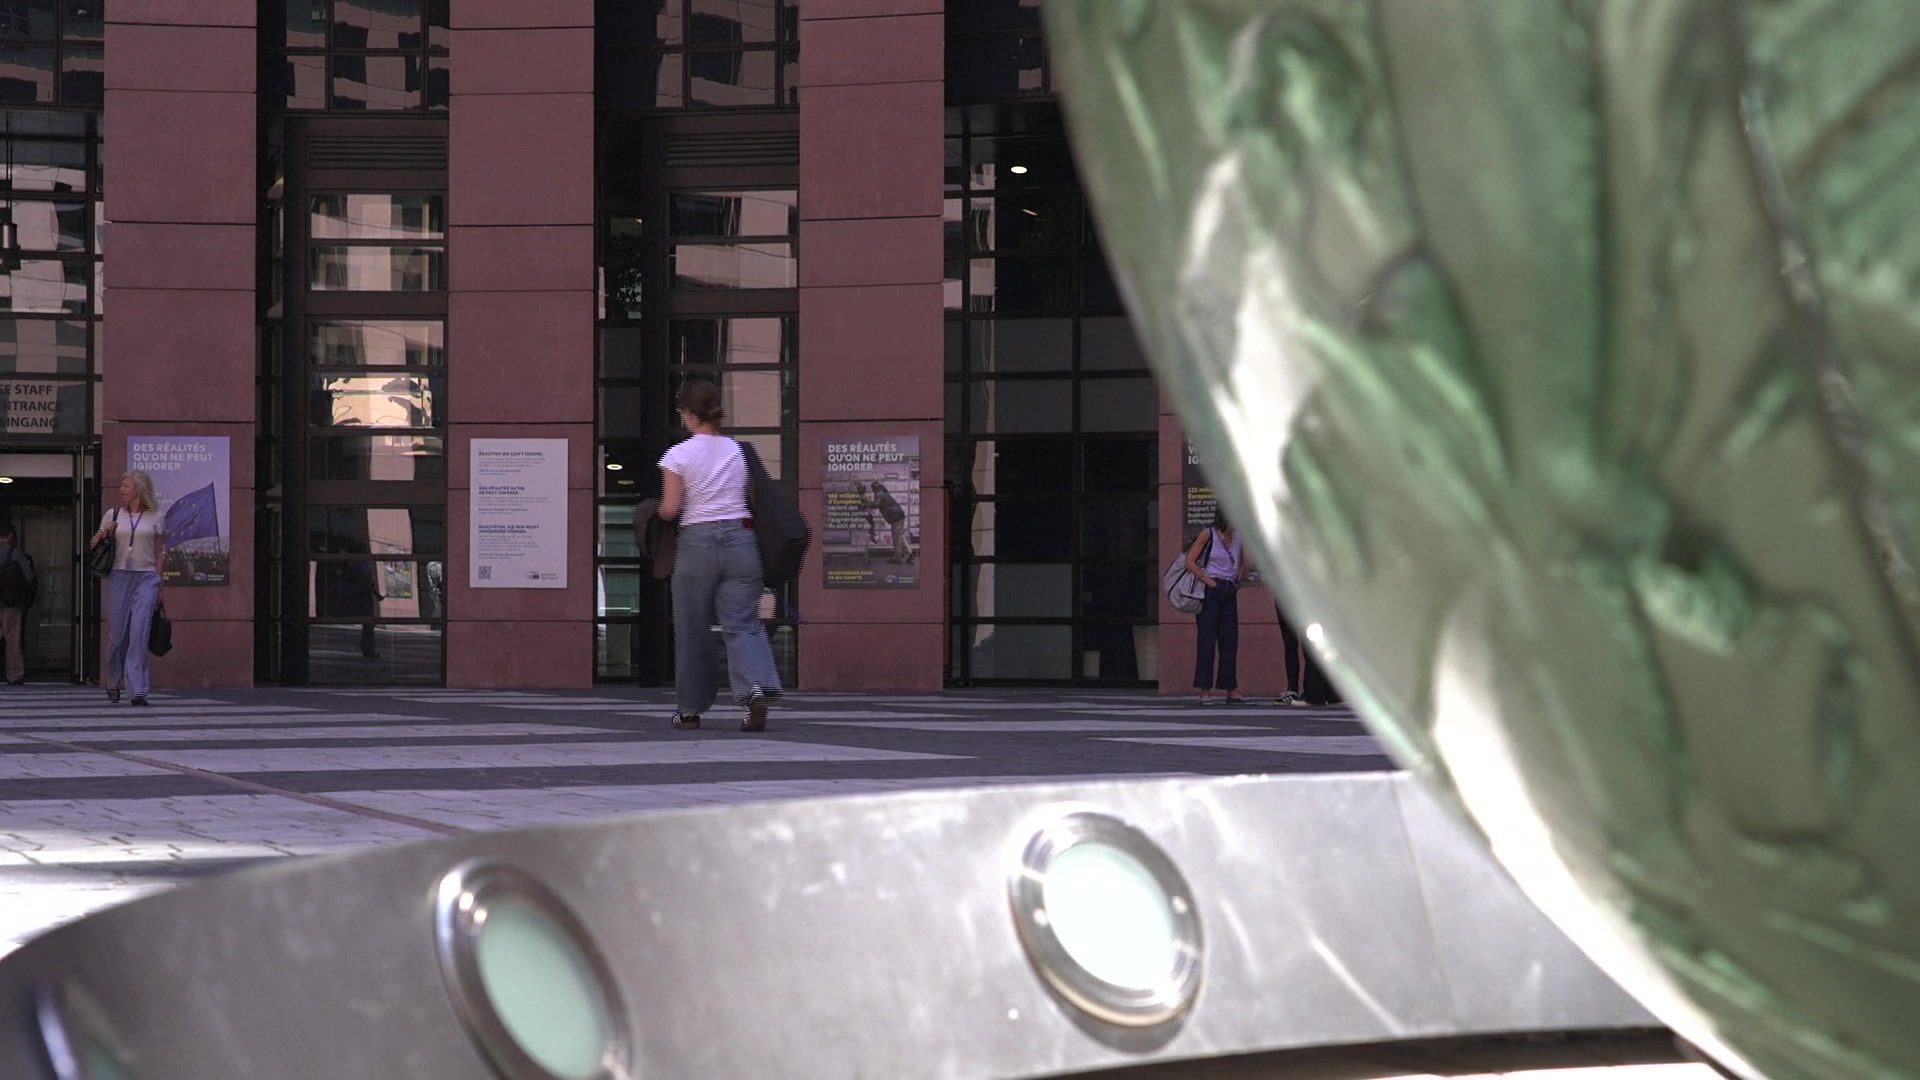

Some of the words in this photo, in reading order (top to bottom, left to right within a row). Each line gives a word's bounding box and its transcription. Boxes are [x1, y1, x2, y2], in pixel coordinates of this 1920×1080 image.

[15, 384, 53, 395] STAFF
[0, 400, 62, 412] NTRANCE
[133, 443, 154, 452] DES
[156, 441, 206, 452] RÉALITÉS
[828, 444, 848, 453] DES
[850, 441, 897, 453] RÉALITÉS
[133, 452, 167, 461] QU'ON
[170, 453, 184, 461] NE
[187, 453, 214, 461] PEUT
[828, 453, 860, 462] QU'ON
[862, 453, 877, 462] NE
[879, 453, 904, 462] PEUT
[133, 462, 181, 471] IGNORER
[828, 462, 873, 471] IGNORER
